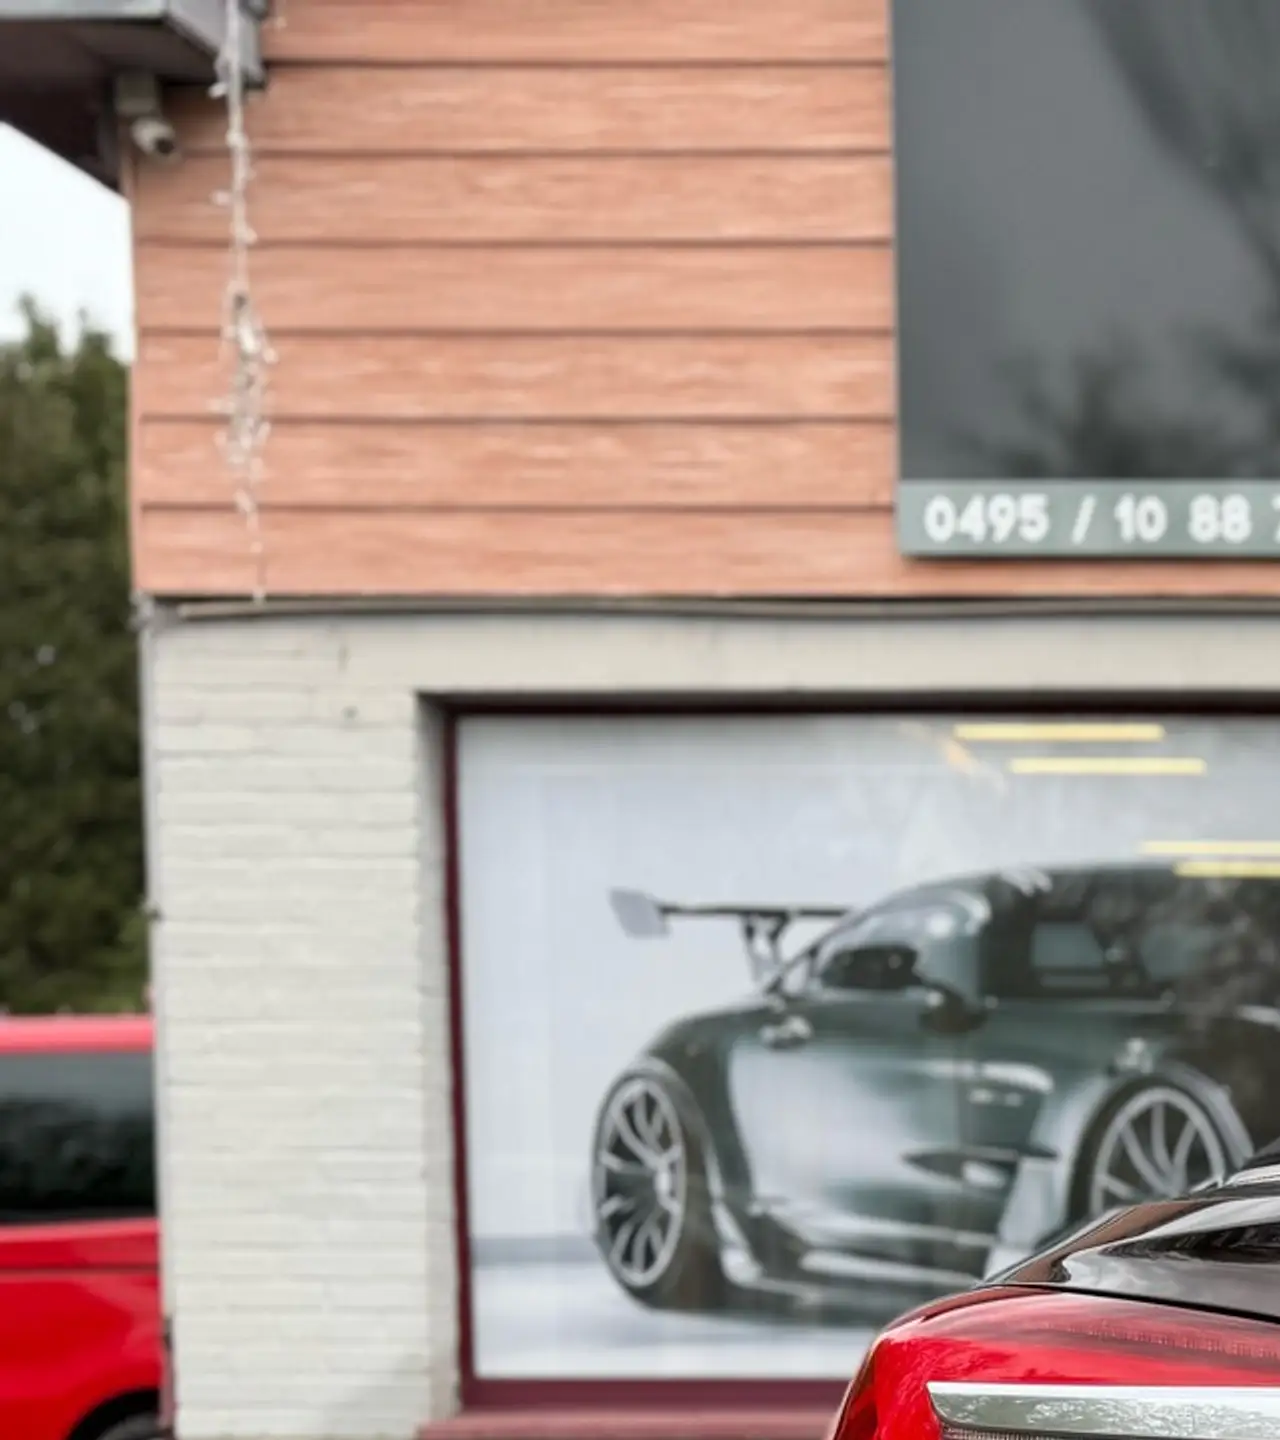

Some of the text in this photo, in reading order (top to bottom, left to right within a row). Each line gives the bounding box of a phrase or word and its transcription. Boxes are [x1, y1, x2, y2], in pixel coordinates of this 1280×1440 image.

[923, 494, 1049, 543] 0495
[1115, 494, 1168, 543] 10
[1188, 494, 1252, 543] 88
